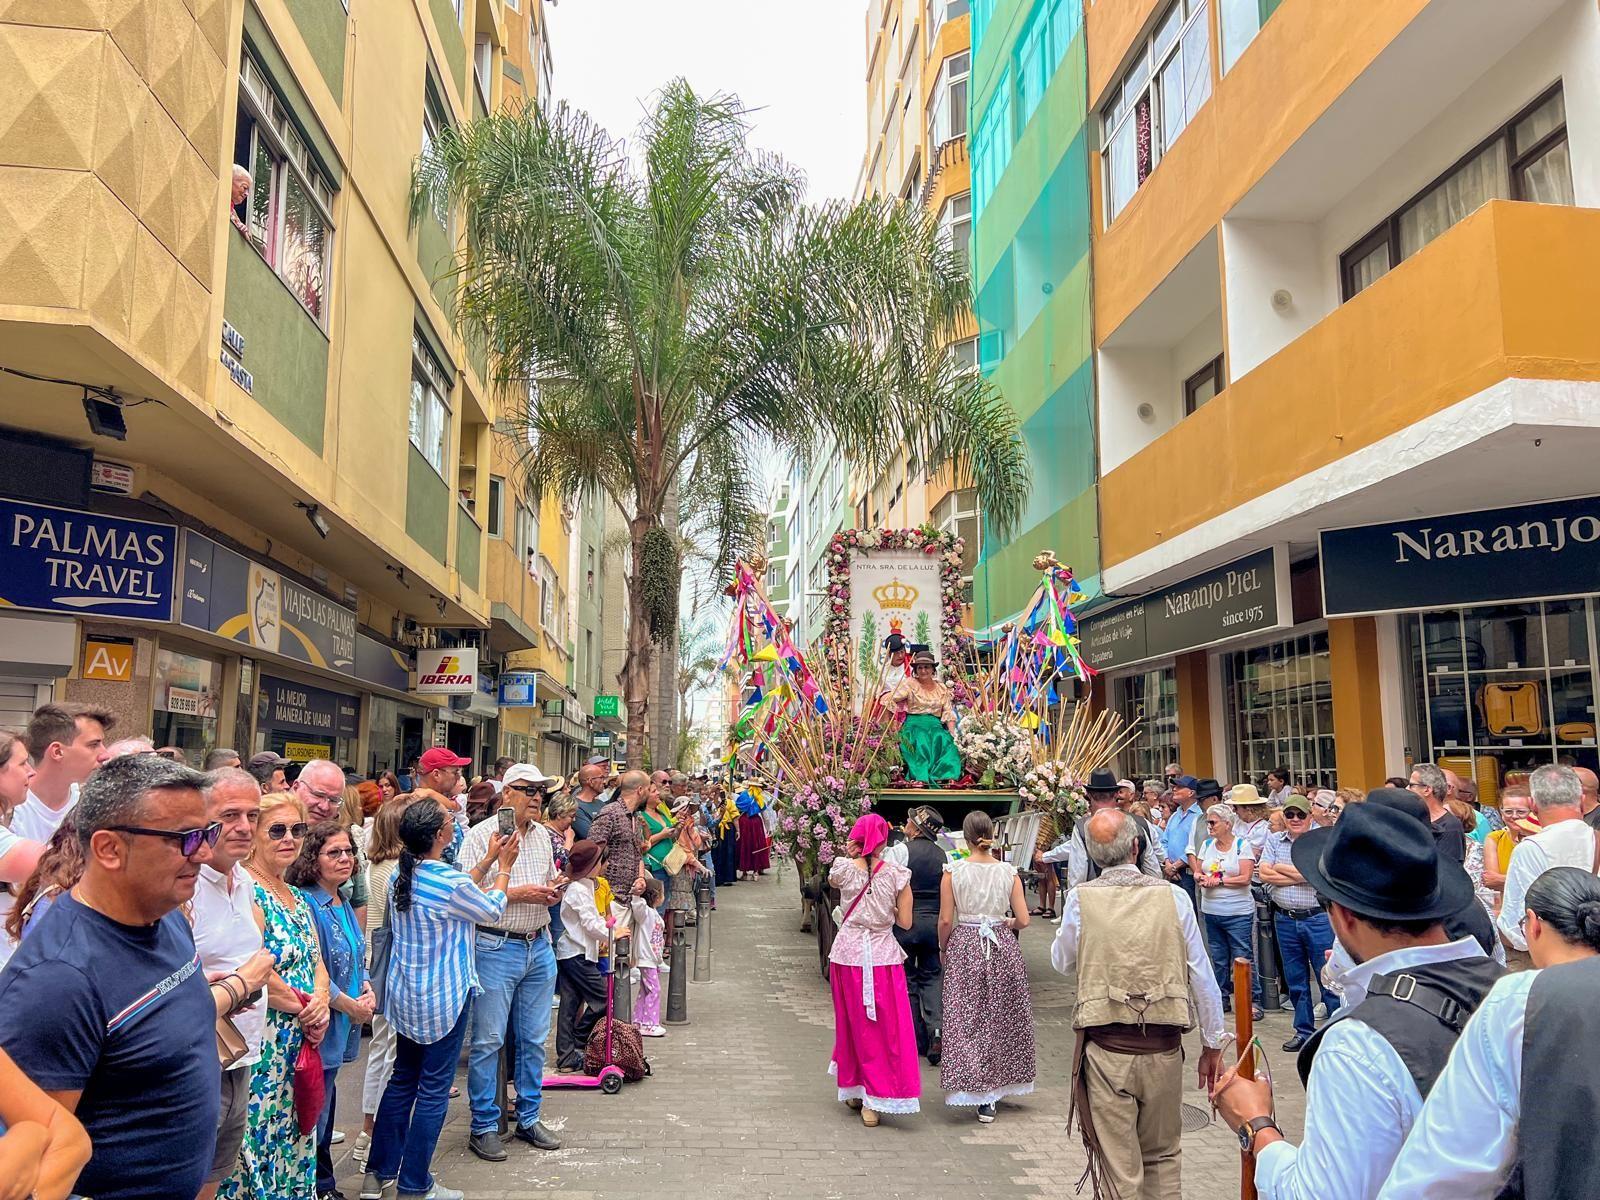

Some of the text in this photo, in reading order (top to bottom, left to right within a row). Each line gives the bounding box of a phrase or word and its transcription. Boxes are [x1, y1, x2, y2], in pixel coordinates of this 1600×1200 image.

[222, 321, 244, 355] CALLE
[11, 513, 165, 566] PALMAS
[44, 557, 162, 599] TRAVEL
[283, 585, 312, 623] VIAJES
[312, 599, 326, 626] LAS
[326, 607, 355, 638] PALMAS
[1126, 611, 1133, 619] en
[1133, 602, 1144, 616] Piel
[1222, 605, 1263, 627] since 1975
[1112, 629, 1119, 640] de
[1119, 624, 1133, 639] Viaje
[332, 634, 354, 660] TRAVEL
[87, 647, 129, 676] Av
[419, 674, 472, 685] IBERIA
[276, 687, 307, 708] LA MEJOR
[275, 705, 331, 728] MANERA DE VIAJAR
